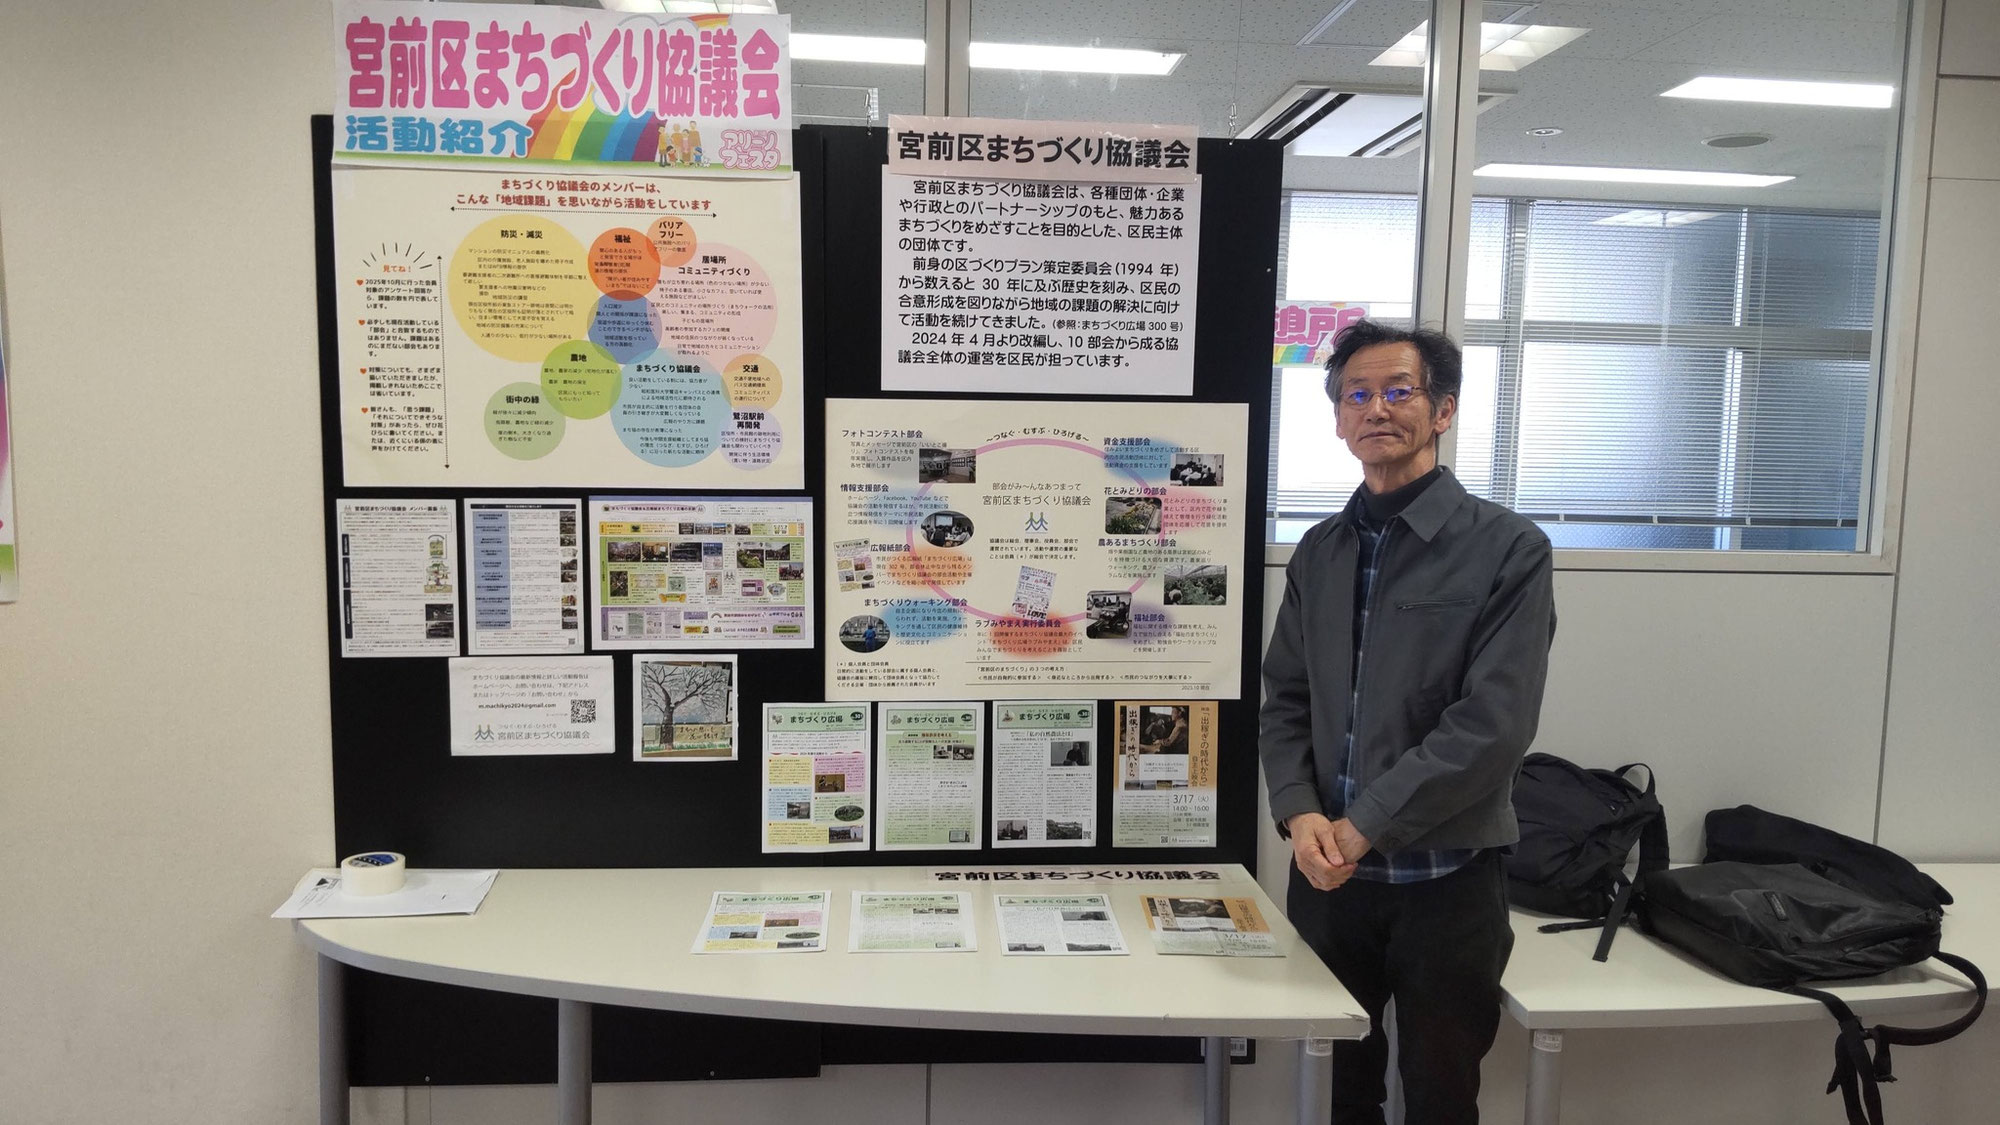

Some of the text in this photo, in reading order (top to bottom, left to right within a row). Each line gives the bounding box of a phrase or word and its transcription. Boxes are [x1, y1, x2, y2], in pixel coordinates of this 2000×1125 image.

[345, 16, 780, 120] 宮前区まちづくり協議会
[345, 115, 533, 156] 活動紹介
[897, 130, 1191, 168] 宮前区まちづくり協議会
[721, 148, 779, 170] フェスタ
[501, 178, 662, 194] まちづくり協議会のメンバーは、
[913, 180, 1185, 201] 宮前区まちづくり協議会は、各種団体・企業
[456, 193, 712, 210] こんな「地域課題」を思いながら活動をしています
[899, 200, 1184, 221] や行政とのパートナーシップのもと、魅力ある
[658, 221, 684, 230] バリア
[899, 219, 1183, 239] まちづくりをめざすことを目的とした、区民主体
[500, 229, 543, 239] 防災・減災
[614, 234, 632, 244] 福祉
[659, 231, 684, 239] フリー
[899, 238, 974, 252] の団体です。
[702, 256, 727, 265] 居場所
[678, 267, 751, 277] コミュニティづくり
[899, 294, 1180, 315] 合意形成を図りながら地域の課題の解決に向け
[899, 350, 1131, 368] 議会全体の運営を区民が担っています。
[636, 364, 701, 374] まちづくり協議会
[743, 364, 759, 373] 交通
[369, 374, 439, 382] いていただきましたが、
[506, 395, 540, 405] 街中の緑
[841, 429, 923, 439] フォトコンテスト部会
[1103, 437, 1151, 446] 資金支援部会
[840, 484, 889, 493] 情報支援部会
[1104, 487, 1167, 496] 花とみどりの部会
[982, 495, 1091, 506] 宮前区まちづくり協議会
[871, 543, 911, 552] 広報紙部会
[1098, 538, 1177, 547] 農あるまちづくり部会
[864, 598, 968, 607] まちづくりウォーキング部会
[1134, 614, 1165, 622] 福祉部会
[975, 619, 1061, 628] ラブみやまえ実行委員会
[790, 715, 843, 724] まちづくり広場
[907, 716, 955, 724] まちづくり広場
[1019, 713, 1071, 721] まちづくり広場
[498, 730, 590, 740] 宮前区まちづくり協議会
[1173, 794, 1194, 804] 3/17
[935, 871, 1222, 882] 宮前区まちづくり協議会
